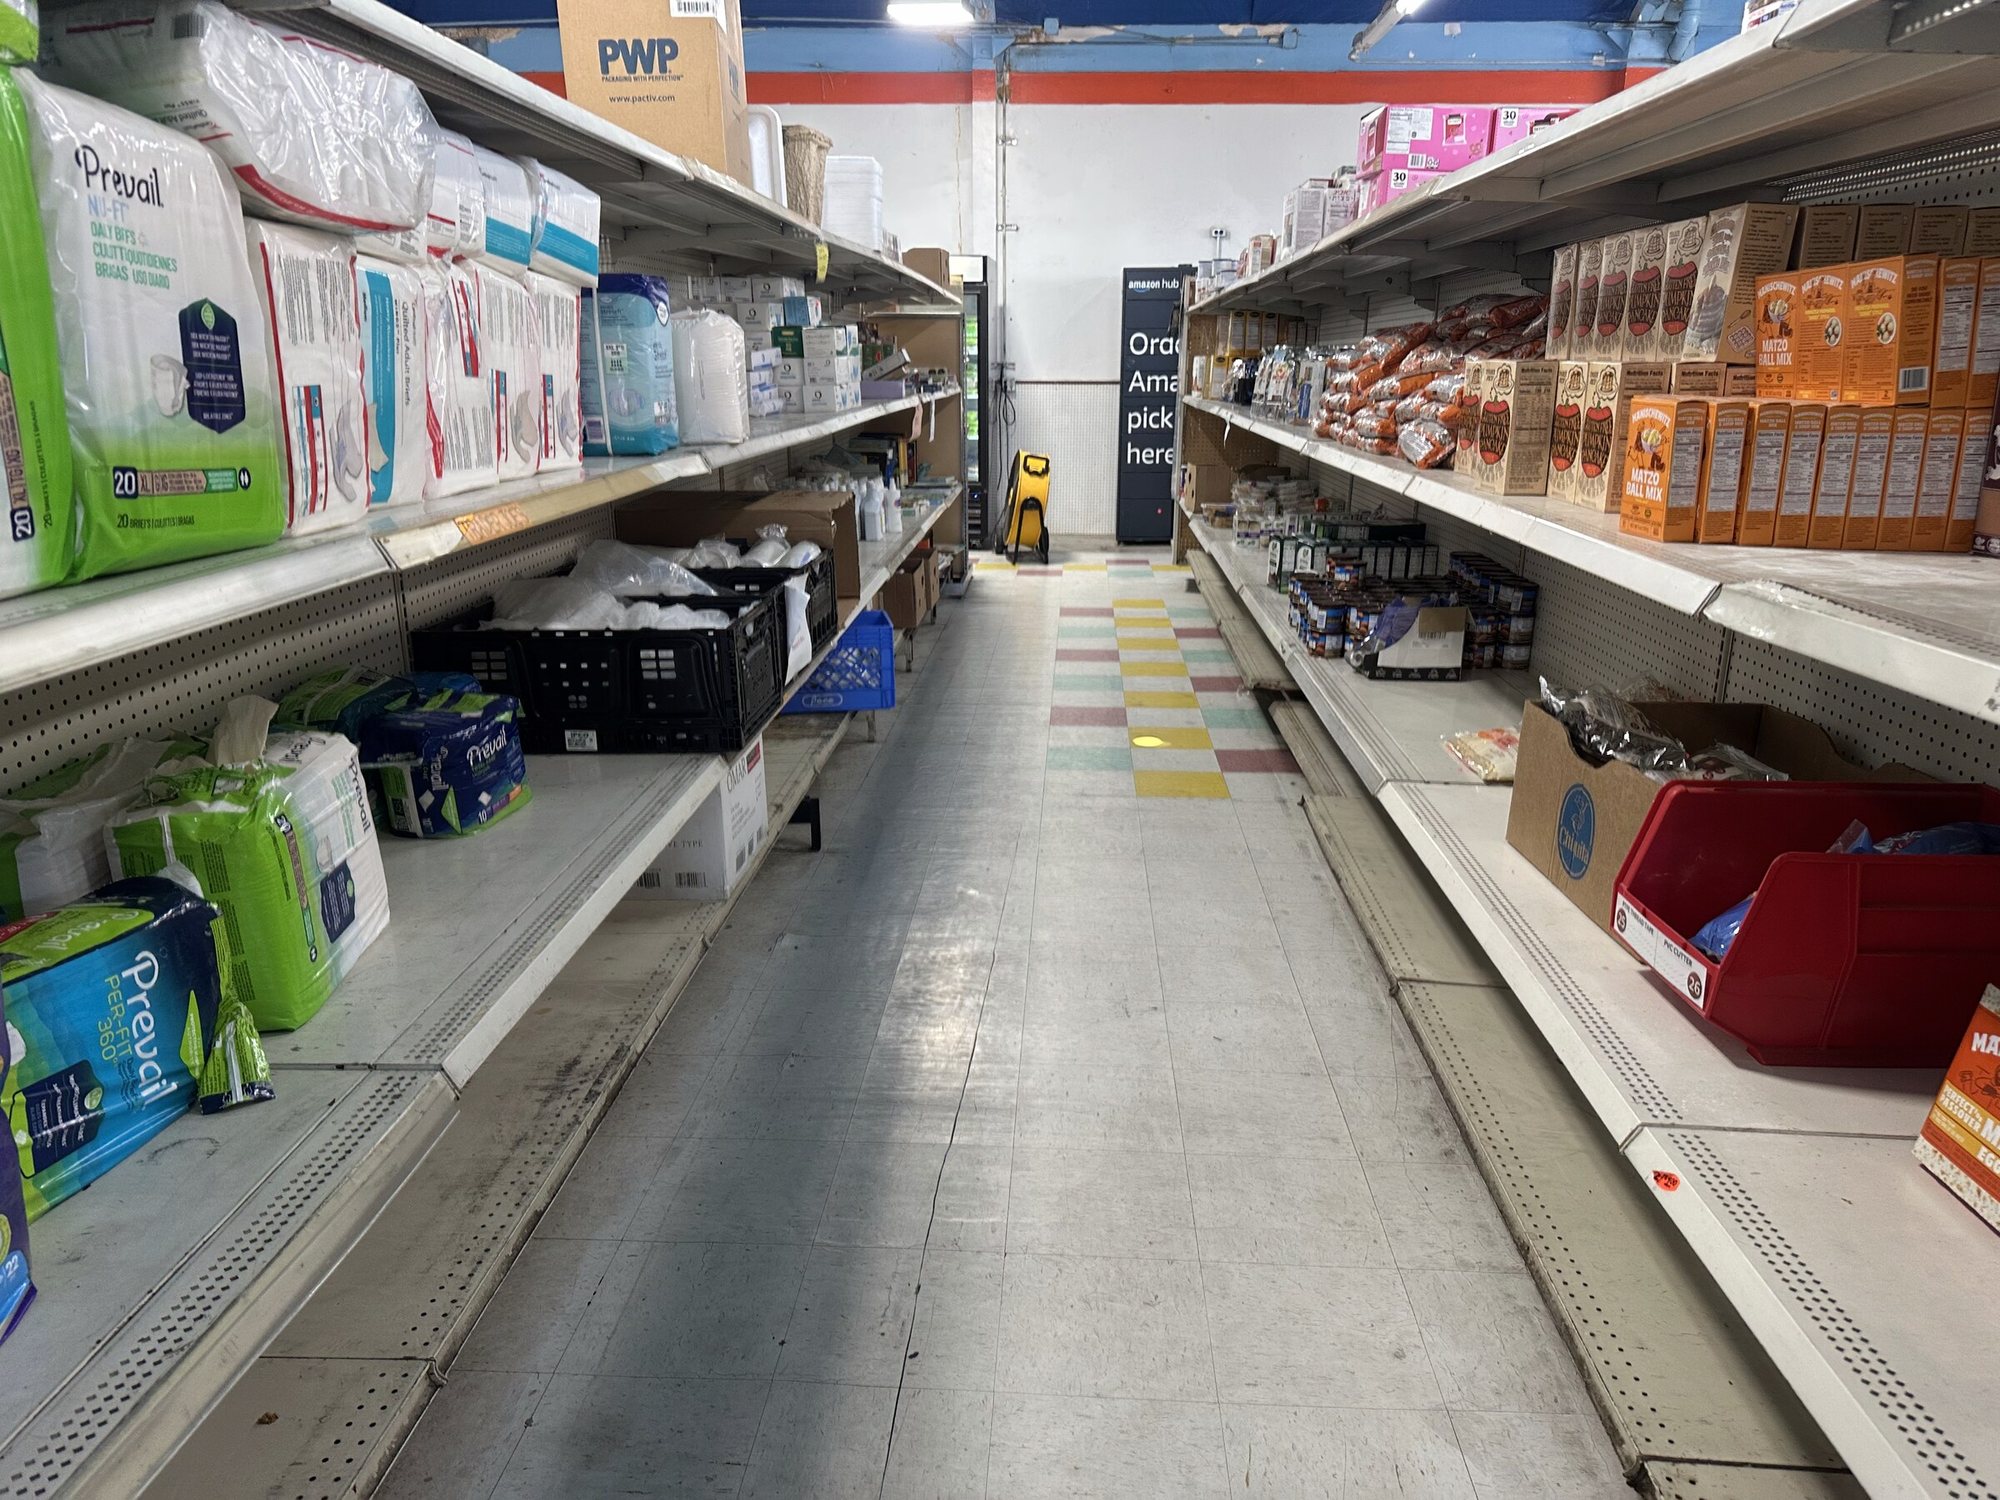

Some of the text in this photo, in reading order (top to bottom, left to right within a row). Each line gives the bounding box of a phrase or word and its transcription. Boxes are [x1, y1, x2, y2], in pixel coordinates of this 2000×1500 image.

[598, 38, 679, 75] PWP
[609, 93, 676, 104] www.pactiv.com
[1503, 110, 1517, 120] 30
[75, 144, 163, 208] Prevail
[1393, 172, 1406, 182] 30
[1128, 277, 1179, 289] amazon hub
[401, 301, 410, 342] Quilted
[1762, 339, 1788, 352] MATZO
[403, 345, 411, 374] Adult
[1759, 352, 1793, 366] BALL MIX
[1127, 442, 1174, 464] here
[114, 471, 137, 495] 20
[140, 474, 151, 492] XL
[1631, 468, 1660, 485] MATZO
[1626, 481, 1663, 502] BALL MIX
[14, 513, 32, 539] 20
[117, 514, 129, 528] 20
[466, 724, 507, 768] Prevail
[348, 757, 371, 834] Prevail
[478, 810, 488, 824] 10
[1560, 826, 1590, 865] Chiquita
[1664, 939, 1693, 967] PVC CUTTER
[1689, 976, 1701, 994] 26
[105, 974, 133, 1057] PER-FIT
[121, 950, 178, 1108] Prevail
[1939, 1095, 1982, 1133] PASSOVER
